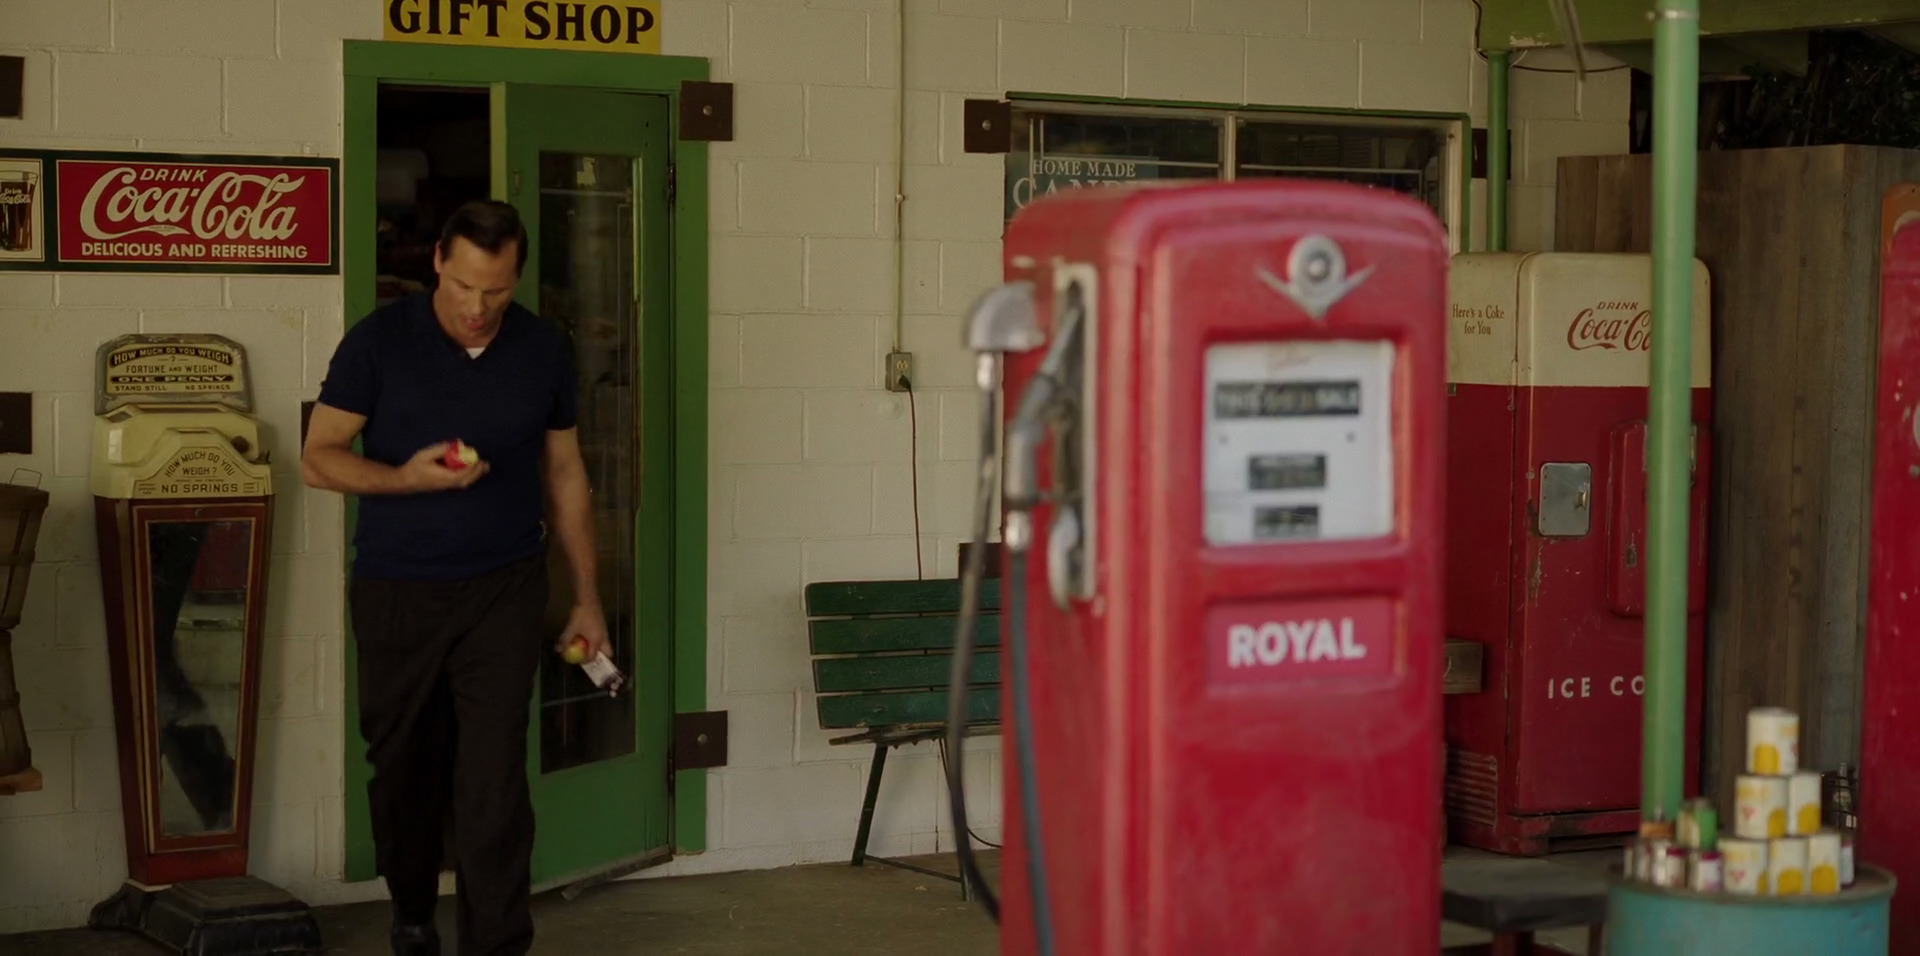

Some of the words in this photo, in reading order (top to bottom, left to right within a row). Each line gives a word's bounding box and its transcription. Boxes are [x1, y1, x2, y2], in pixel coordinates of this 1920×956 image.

[389, 0, 508, 37] GIFT
[524, 1, 654, 44] SHOP
[140, 168, 207, 182] DRINK
[1033, 160, 1081, 176] HOME
[1087, 161, 1136, 178] MADE
[80, 167, 306, 240] Coca-Cola
[82, 242, 163, 257] DELICIOUS
[168, 243, 206, 258] AND
[211, 244, 308, 259] REFRESHING
[1478, 310, 1483, 319] a
[1485, 305, 1505, 320] Coke
[1597, 301, 1639, 311] DRINK
[1464, 322, 1475, 337] for
[1477, 321, 1492, 336] You
[113, 352, 137, 365] HOW
[139, 348, 163, 357] MUCH
[166, 346, 176, 354] DO
[179, 347, 195, 355] YOU
[197, 350, 230, 364] WEIGH
[125, 364, 166, 374] FORTUNE
[184, 364, 218, 373] WEIGHT
[118, 375, 156, 383] ONE
[164, 375, 226, 383] PENNY
[165, 459, 180, 477] HOW
[181, 450, 206, 464] MUCH
[208, 452, 220, 463] DO
[222, 459, 236, 477] YOU
[183, 466, 210, 476] WEIGH
[161, 484, 178, 493] NO
[183, 483, 238, 493] SPRINGS
[1228, 616, 1367, 668] ROYAL
[1548, 678, 1591, 699] ICE
